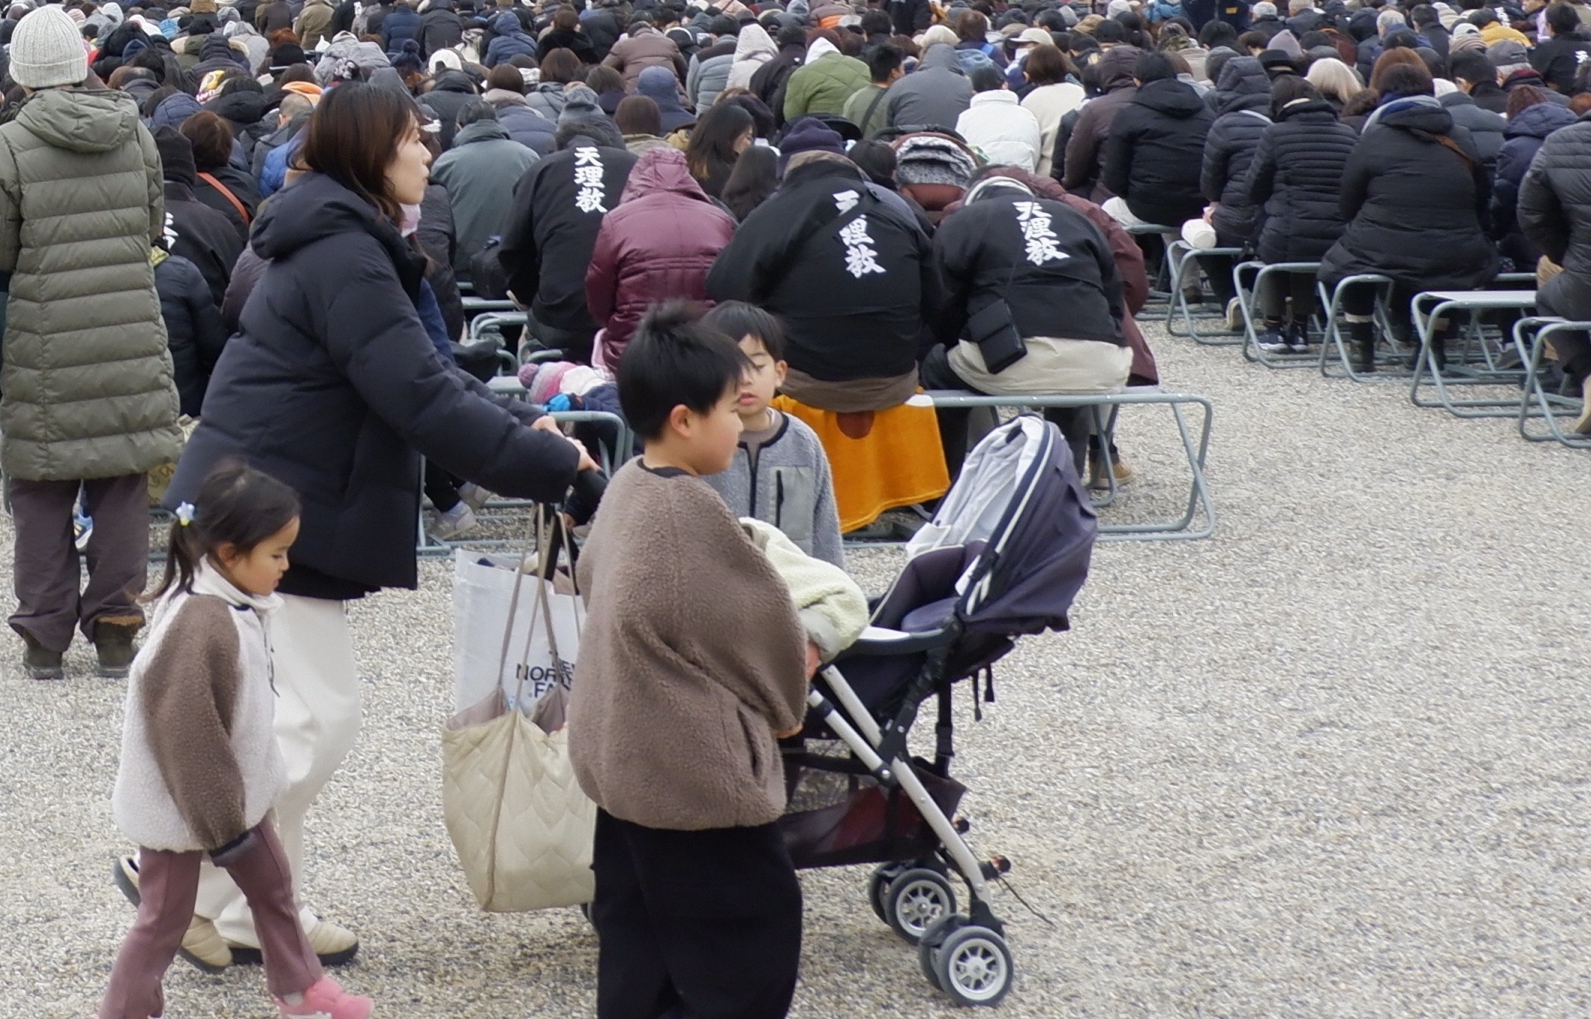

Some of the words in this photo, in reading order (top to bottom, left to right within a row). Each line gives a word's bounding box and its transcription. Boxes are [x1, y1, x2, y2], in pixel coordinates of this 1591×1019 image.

[573, 146, 608, 213] 天理教
[1012, 201, 1070, 266] 天理教
